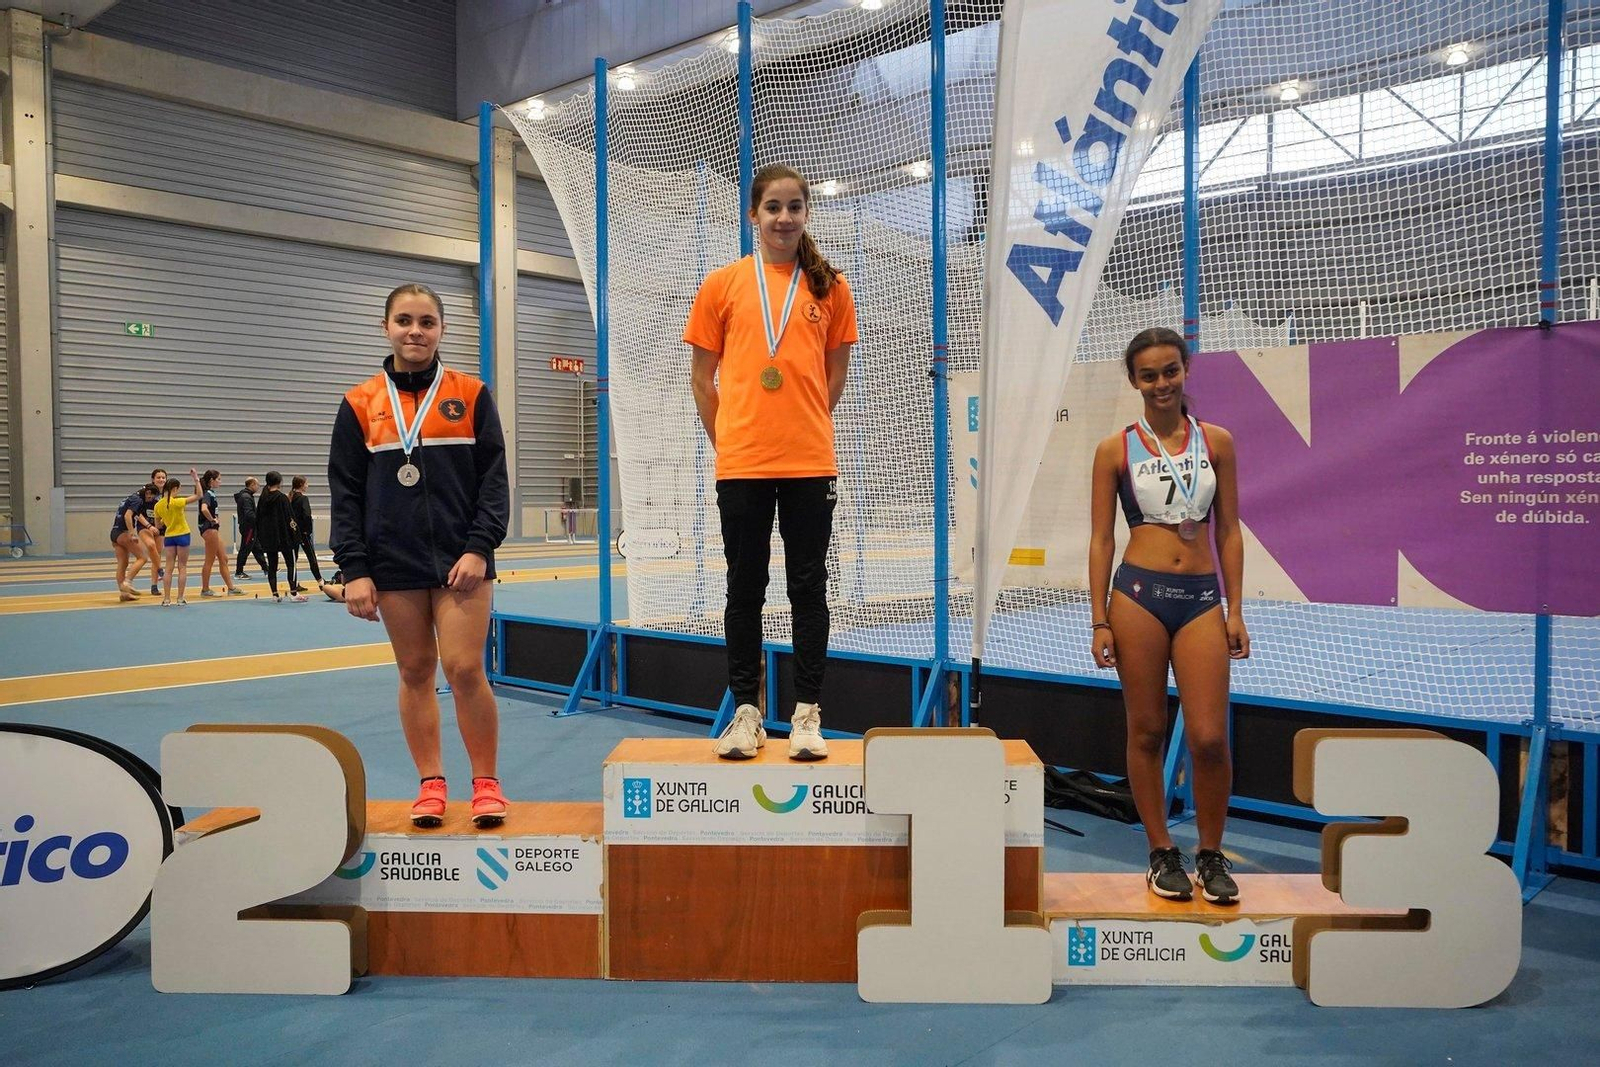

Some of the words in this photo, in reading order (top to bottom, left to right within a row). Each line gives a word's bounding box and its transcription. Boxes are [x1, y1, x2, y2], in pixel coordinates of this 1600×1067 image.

[1006, 0, 1187, 327] Atlánti
[1054, 409, 1069, 421] IA
[1465, 433, 1522, 446] Fronte
[1526, 430, 1537, 444] á
[1542, 429, 1600, 444] violen
[1463, 452, 1485, 465] de
[1489, 451, 1550, 464] xénero
[1555, 449, 1577, 463] só
[1477, 471, 1521, 484] unha
[1460, 490, 1492, 504] Sen
[1498, 490, 1560, 507] ningún
[1495, 510, 1517, 523] de
[1522, 510, 1590, 524] dúbida.
[656, 782, 707, 796] XUNTA
[812, 785, 863, 799] GALICI
[656, 799, 675, 813] DE
[678, 798, 740, 813] GALICIA
[0, 814, 129, 887] ico
[515, 848, 580, 859] DEPORTE
[151, 726, 362, 996] 2
[380, 852, 441, 866] GALICIA
[515, 861, 573, 872] GALEGO
[857, 734, 1053, 1005] 1
[1302, 735, 1523, 1009] 3
[380, 867, 460, 881] SAUDABLE
[1101, 931, 1153, 944] XUNTA
[1259, 934, 1291, 947] GAL
[1101, 948, 1119, 961] DE
[1123, 947, 1186, 961] GALICIA
[1259, 950, 1292, 963] SAU
